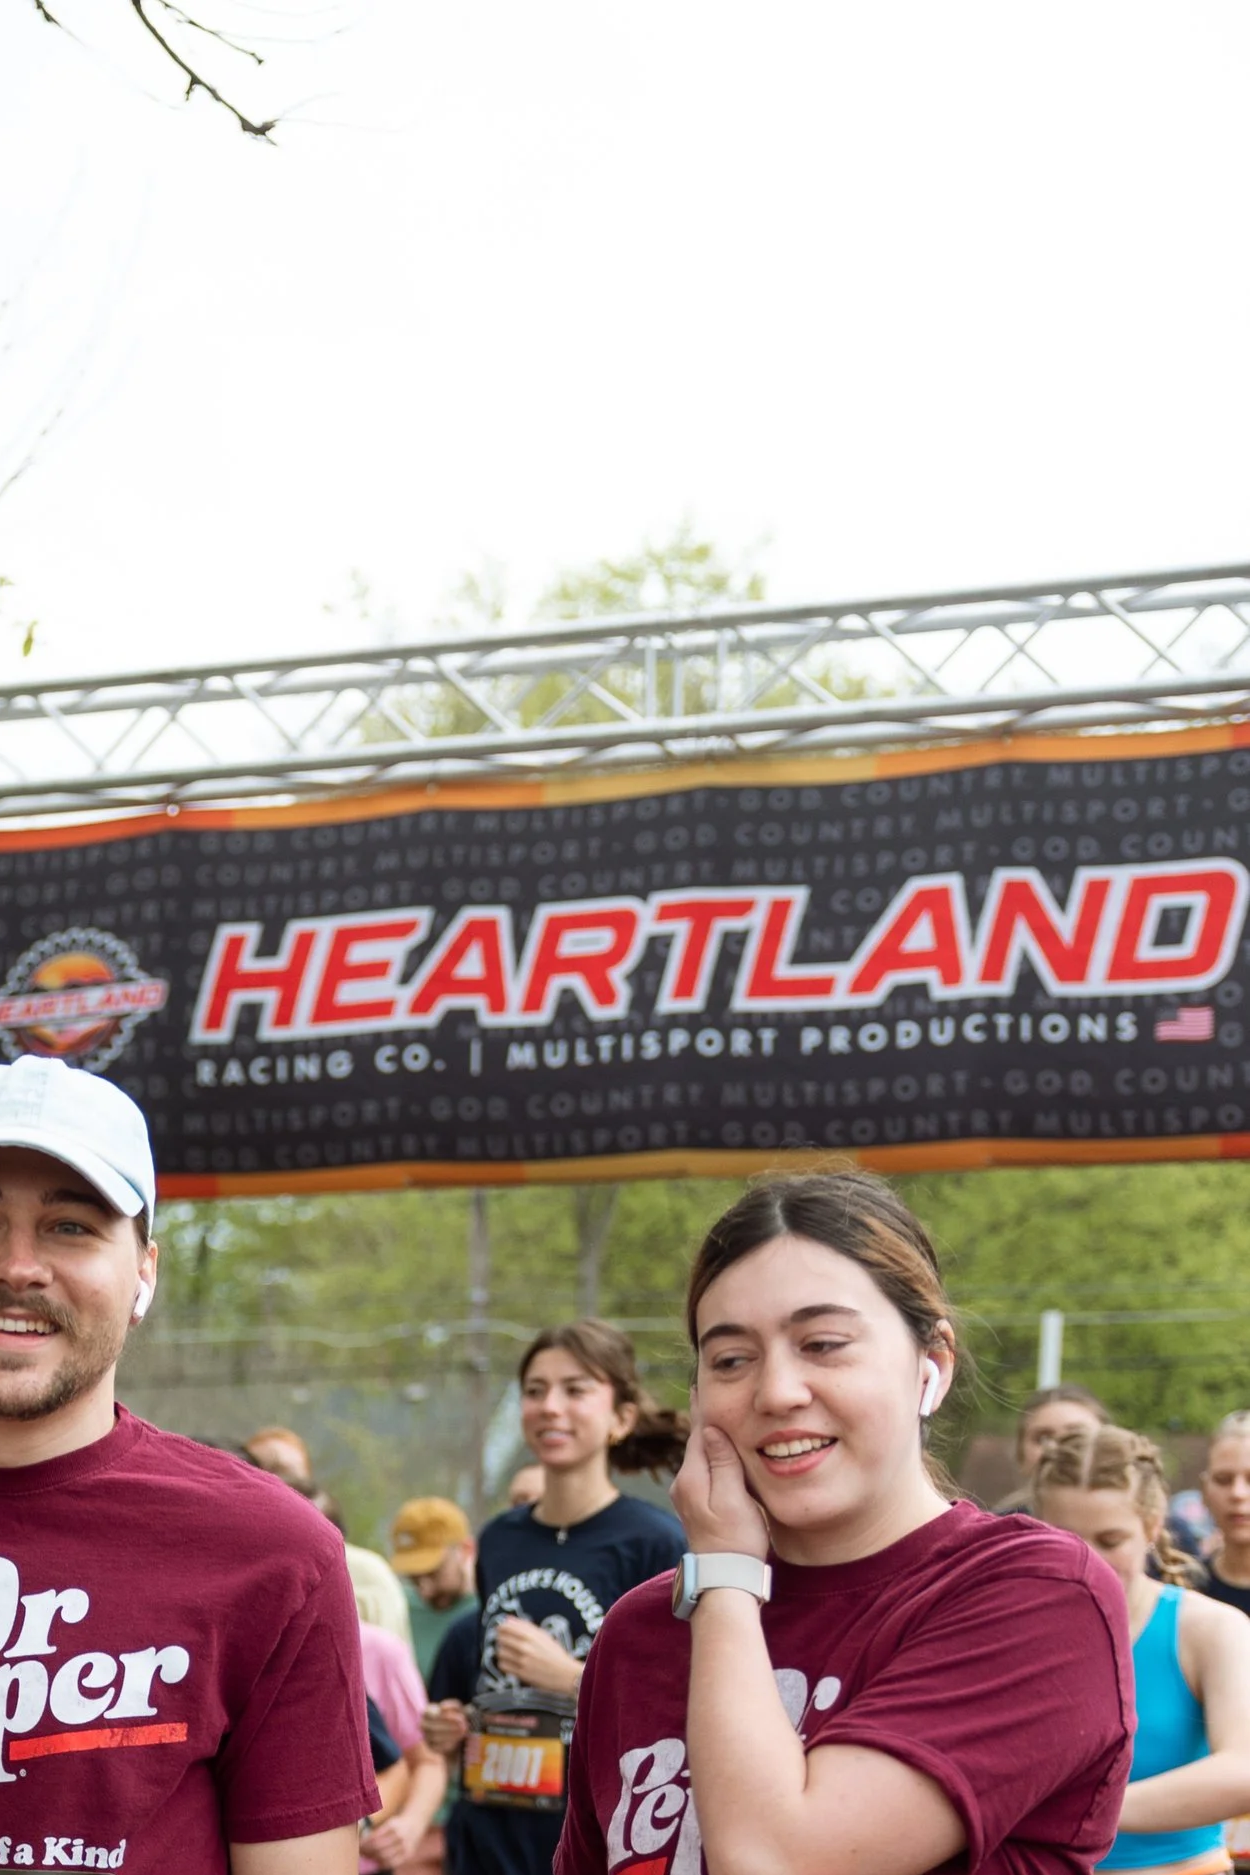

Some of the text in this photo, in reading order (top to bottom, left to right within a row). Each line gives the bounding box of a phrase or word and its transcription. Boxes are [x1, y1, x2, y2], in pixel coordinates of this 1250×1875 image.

[1046, 751, 1250, 789] MULTISPO
[187, 857, 1250, 1045] HEARTLAND
[196, 1049, 354, 1087] RACING
[374, 1043, 447, 1075] CO.
[506, 1027, 778, 1071] MULTISPORT
[799, 1011, 1140, 1056] PRODUCTIONS
[1113, 1061, 1250, 1096] COUNT
[1033, 1103, 1245, 1134] MULTISPO
[13, 1844, 34, 1865] a
[42, 1837, 126, 1869] Kind
